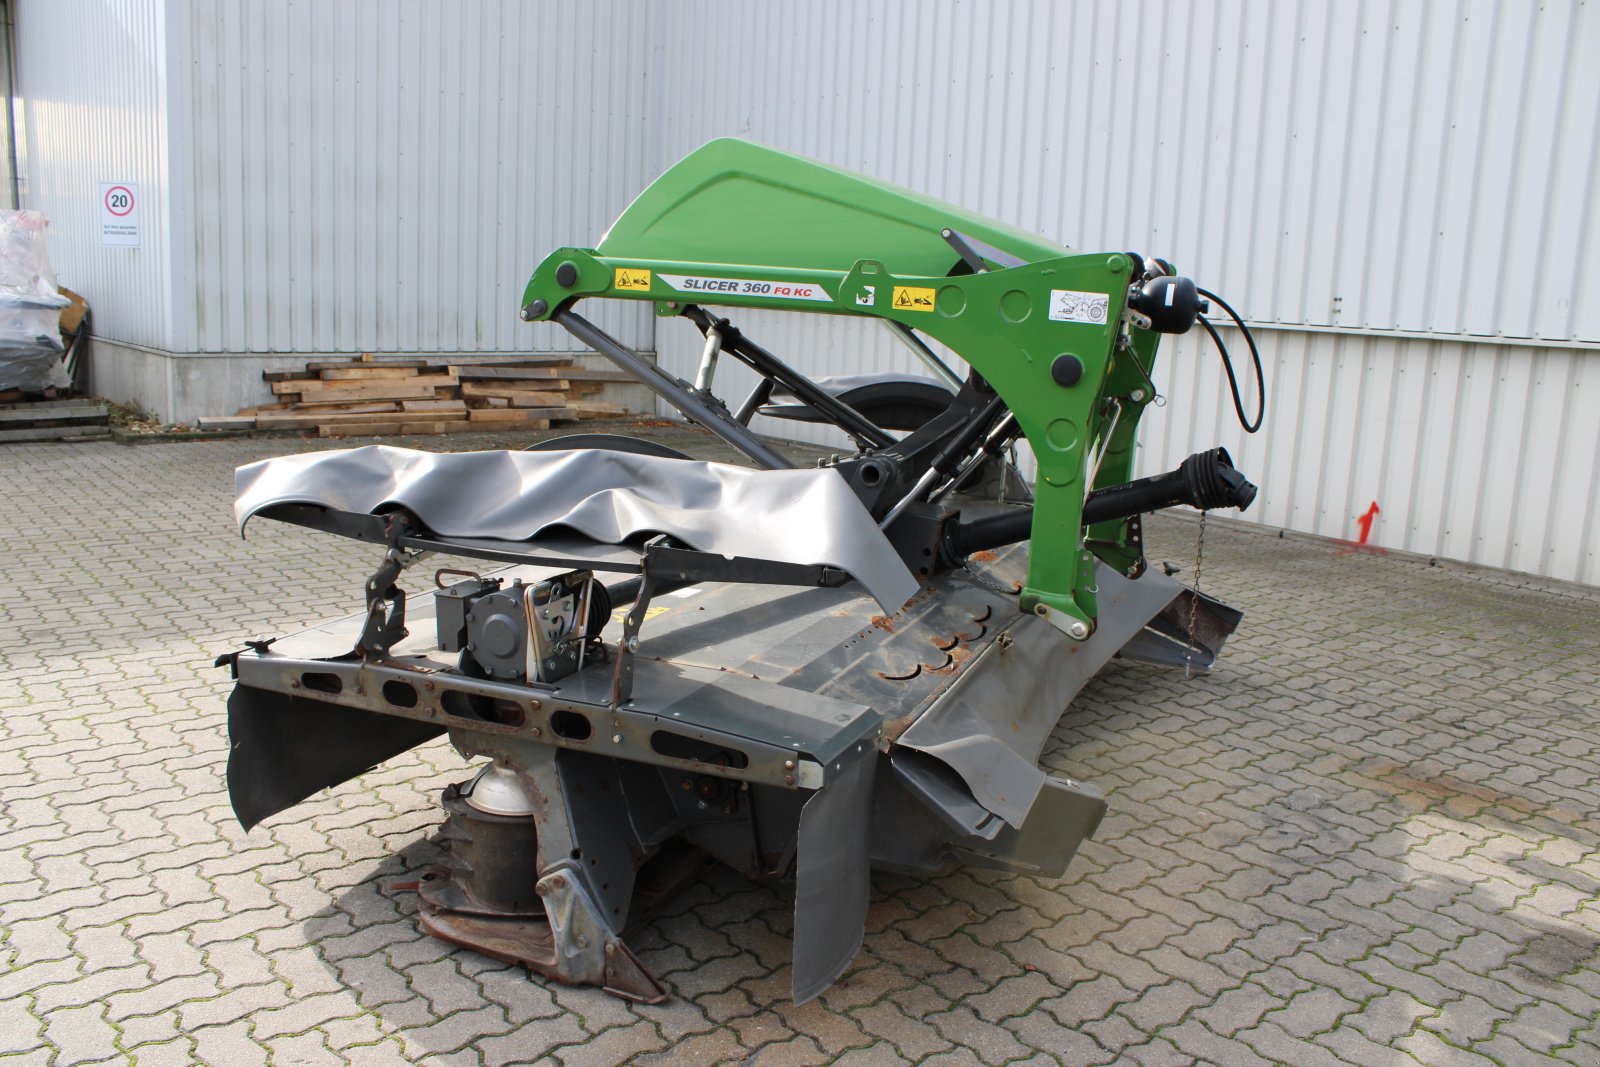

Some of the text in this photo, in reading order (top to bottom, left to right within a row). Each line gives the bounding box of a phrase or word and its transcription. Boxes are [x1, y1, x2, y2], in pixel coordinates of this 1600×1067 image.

[111, 194, 128, 208] 20
[683, 278, 813, 297] SLICER 360 FQ KC
